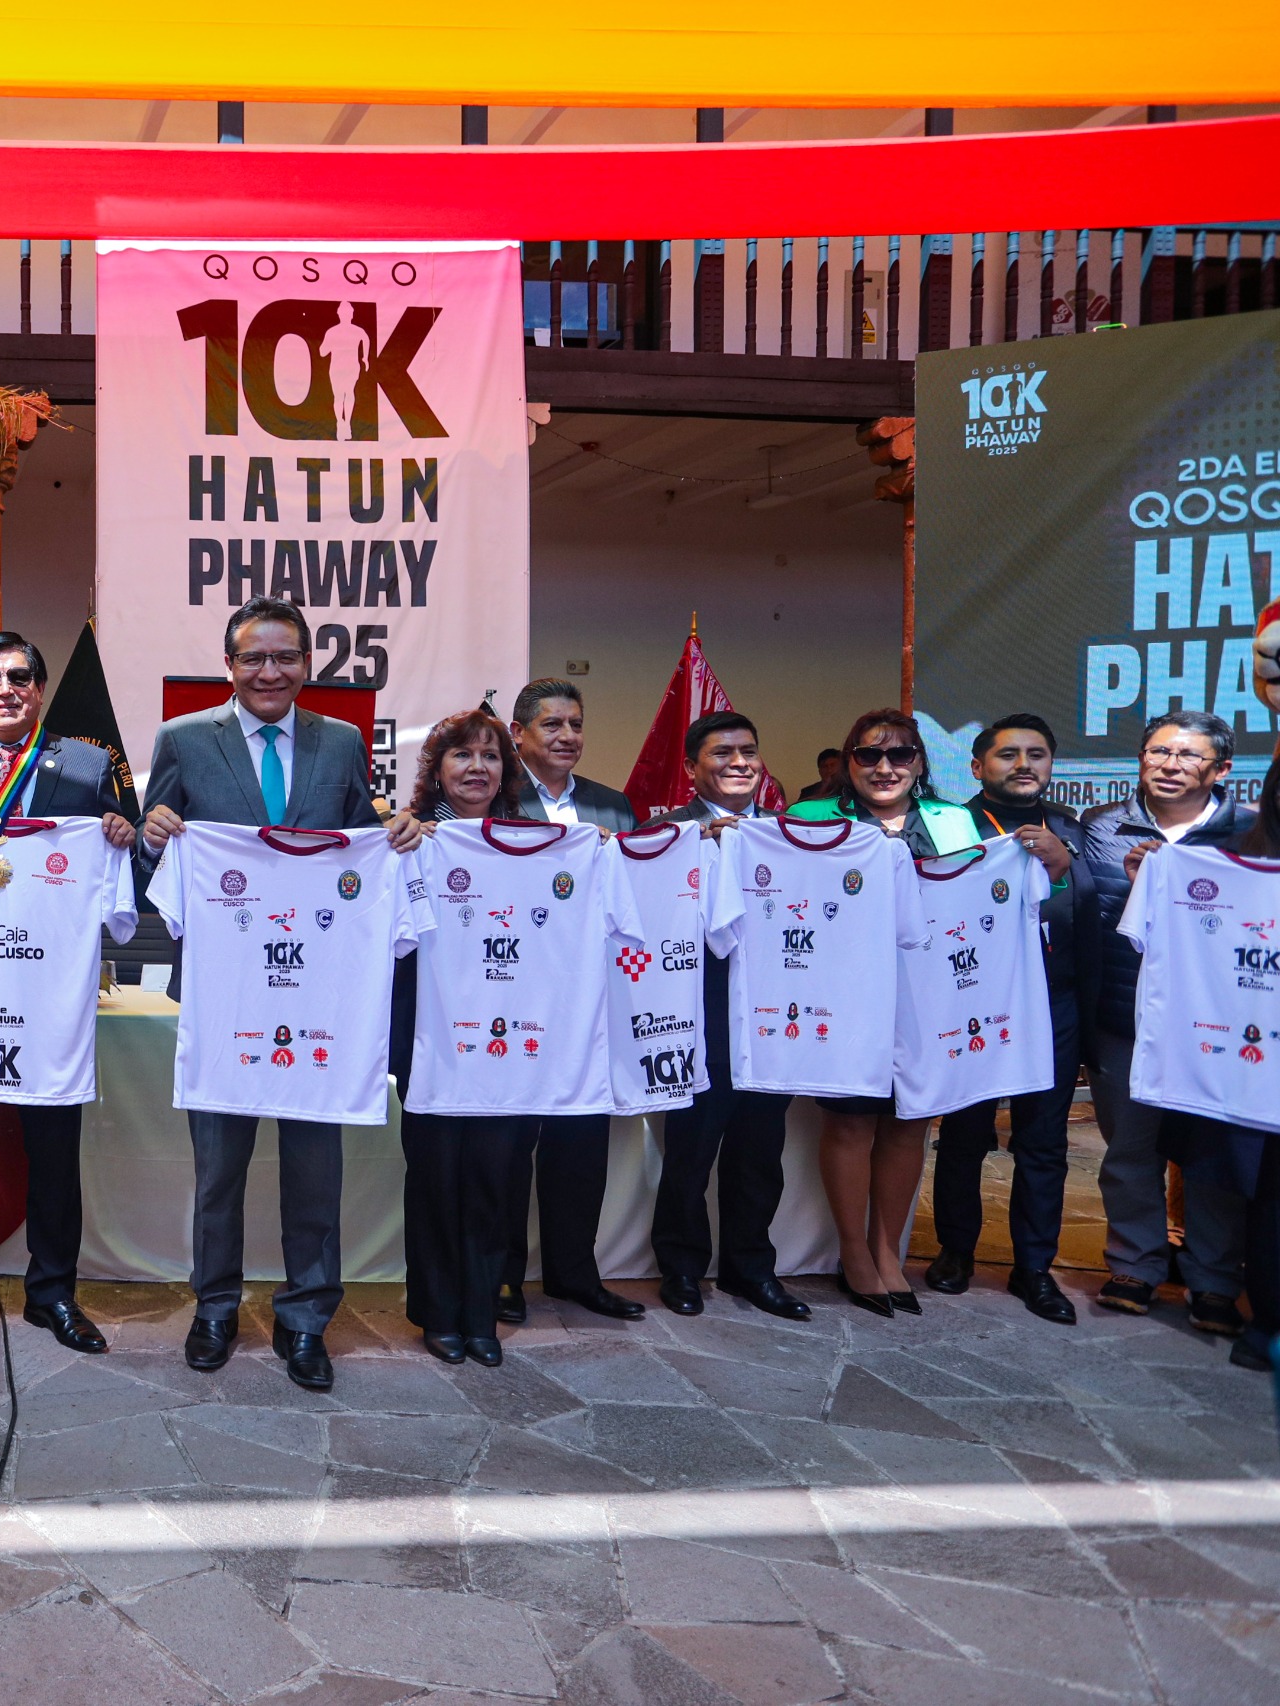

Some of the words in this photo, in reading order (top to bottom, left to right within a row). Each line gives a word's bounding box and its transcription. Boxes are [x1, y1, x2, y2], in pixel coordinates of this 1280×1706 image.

[203, 254, 417, 286] QOSQO
[176, 299, 449, 441] 10K
[960, 370, 1048, 420] 10K
[965, 416, 1041, 436] HATUN
[965, 430, 1042, 449] PHAWAY
[988, 446, 1018, 456] 2025
[1178, 454, 1247, 482] 2DA
[188, 455, 438, 523] HATUN
[188, 538, 437, 607] PHAWAY
[308, 624, 389, 692] 25
[1085, 638, 1280, 737] PHA
[117, 762, 134, 788] PERU
[1188, 904, 1214, 912] CUSCO
[483, 938, 520, 959] 10K
[661, 939, 695, 956] Caja
[782, 929, 815, 949] 10K
[263, 942, 304, 965] 10K
[947, 946, 979, 972] 10K
[1233, 947, 1280, 971] 10K
[640, 1020, 695, 1037] NAKAMURA
[647, 1042, 692, 1054] QOSQO
[639, 1047, 695, 1087] 10K
[645, 1085, 671, 1095] HATUN
[668, 1090, 686, 1098] 2025
